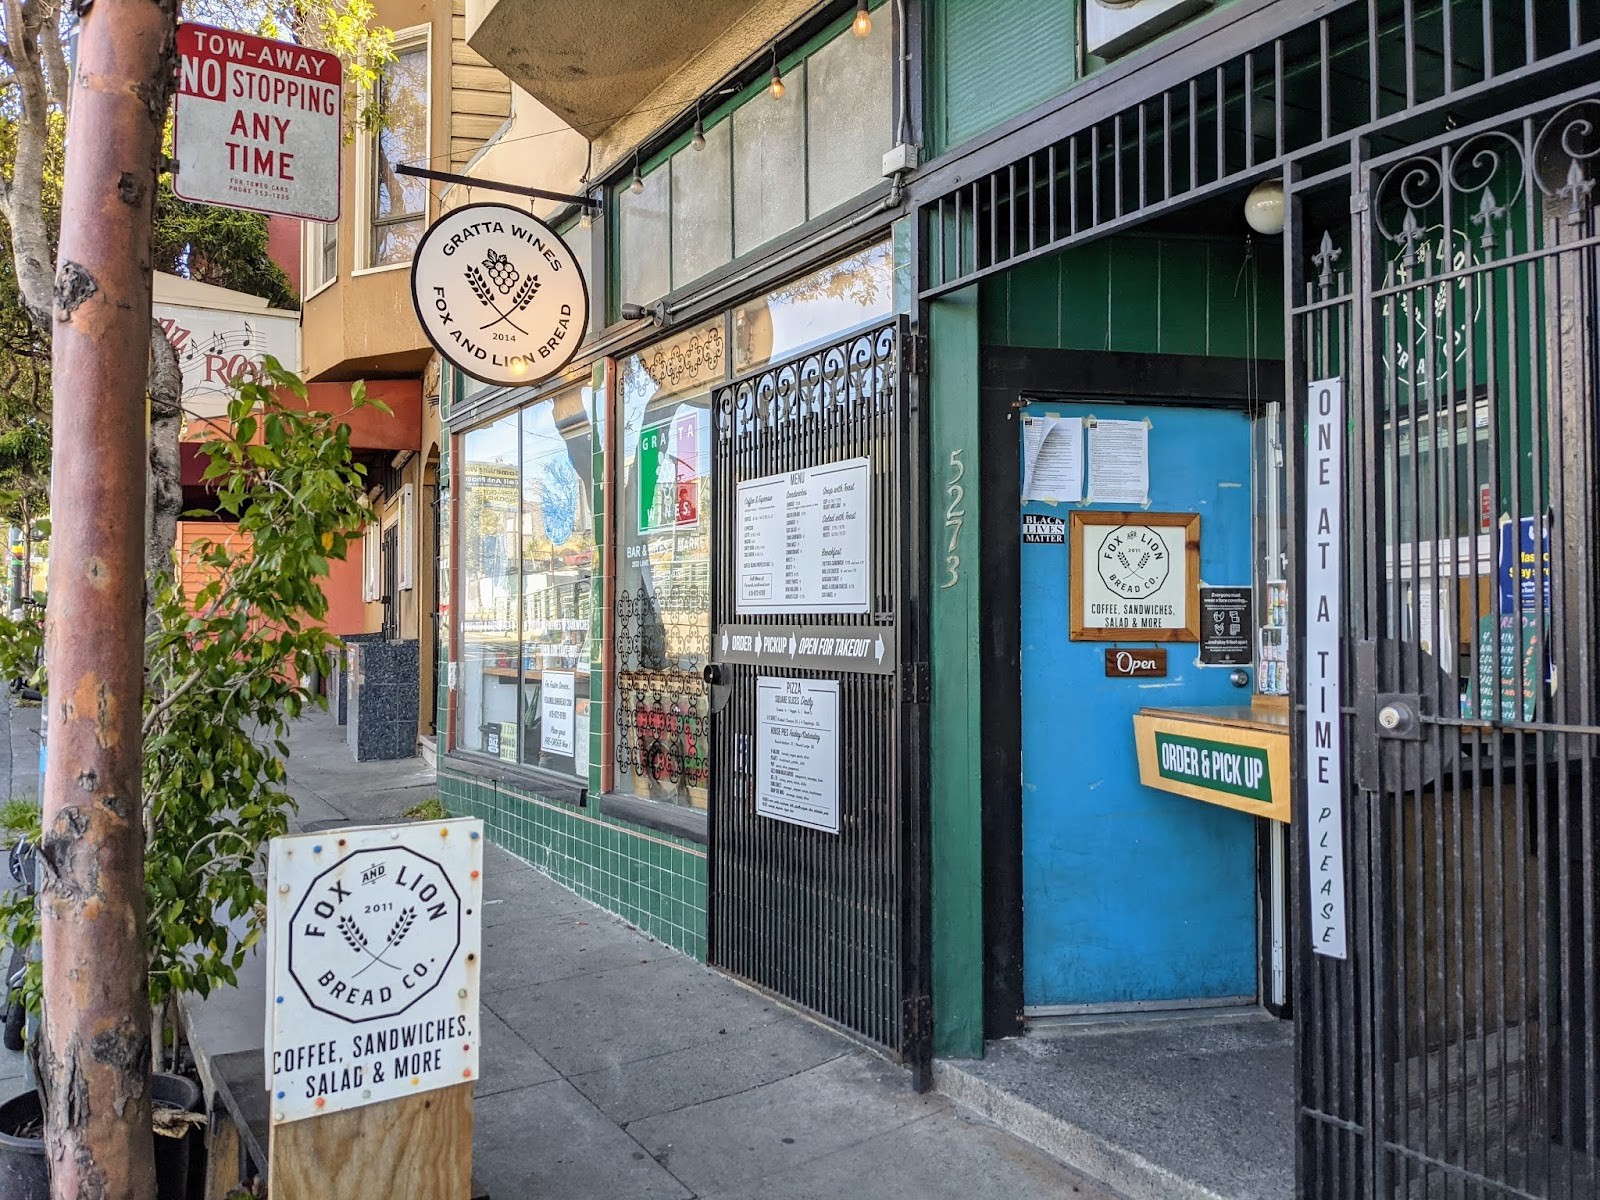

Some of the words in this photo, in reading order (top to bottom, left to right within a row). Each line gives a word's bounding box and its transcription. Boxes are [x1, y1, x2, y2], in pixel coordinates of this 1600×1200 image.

[194, 31, 326, 76] TOW-AWAY
[180, 54, 222, 97] NO
[233, 69, 335, 116] STOPPING
[230, 109, 291, 145] ANY
[225, 142, 294, 181] TIME
[229, 186, 252, 195] PHONE
[230, 178, 243, 186] FOR
[271, 184, 289, 193] CARS
[442, 221, 504, 257] GRATTA
[511, 224, 563, 272] WINES
[433, 286, 455, 326] FOX
[450, 329, 487, 360] AND
[492, 352, 535, 368] LION
[538, 303, 571, 359] BREAD
[492, 332, 516, 343] 2014
[642, 424, 694, 451] GRATA
[1317, 389, 1331, 487] ONE
[790, 471, 806, 486] MENU
[647, 501, 689, 521] WNES
[941, 449, 965, 589] 5273
[1025, 515, 1064, 525] BLACK
[1025, 534, 1062, 543] MATTER
[1026, 525, 1063, 534] LIVES
[1316, 508, 1332, 571] AT
[627, 546, 641, 558] BAR
[1104, 536, 1123, 560] FOX
[1141, 533, 1163, 560] LION
[1109, 574, 1140, 593] BREAD
[1144, 576, 1159, 589] CO.
[1091, 604, 1120, 616] COFFEE,
[1123, 604, 1175, 616] SANDWICHES,
[1105, 617, 1129, 628] SALAD
[1132, 617, 1138, 628] &
[1141, 617, 1162, 628] MORE
[1316, 595, 1331, 624] A
[732, 635, 752, 652] ORDER
[763, 636, 787, 654] PICKUP
[799, 637, 819, 655] OPEN
[818, 638, 837, 656] FOR
[834, 638, 871, 658] TAKEOUT
[1116, 651, 1157, 676] Open
[786, 682, 802, 695] PIZZA
[800, 696, 814, 711] Daily
[1314, 651, 1332, 785] TIME
[1161, 742, 1199, 777] ORDER
[1201, 749, 1210, 779] &
[1213, 751, 1242, 786] PICK
[1244, 756, 1264, 790] UP
[1317, 806, 1335, 944] PLEASE
[305, 880, 353, 938] FOX
[361, 864, 386, 884] AND
[395, 866, 448, 921] LION
[364, 902, 393, 914] 2011
[317, 970, 393, 1006] BREAD
[402, 957, 436, 989] CO.
[273, 1041, 343, 1075] COFFEE,
[353, 1015, 472, 1059] SANDWICHES,
[305, 1066, 363, 1099] SALAD
[373, 1061, 385, 1084] &
[394, 1049, 442, 1080] MORE
